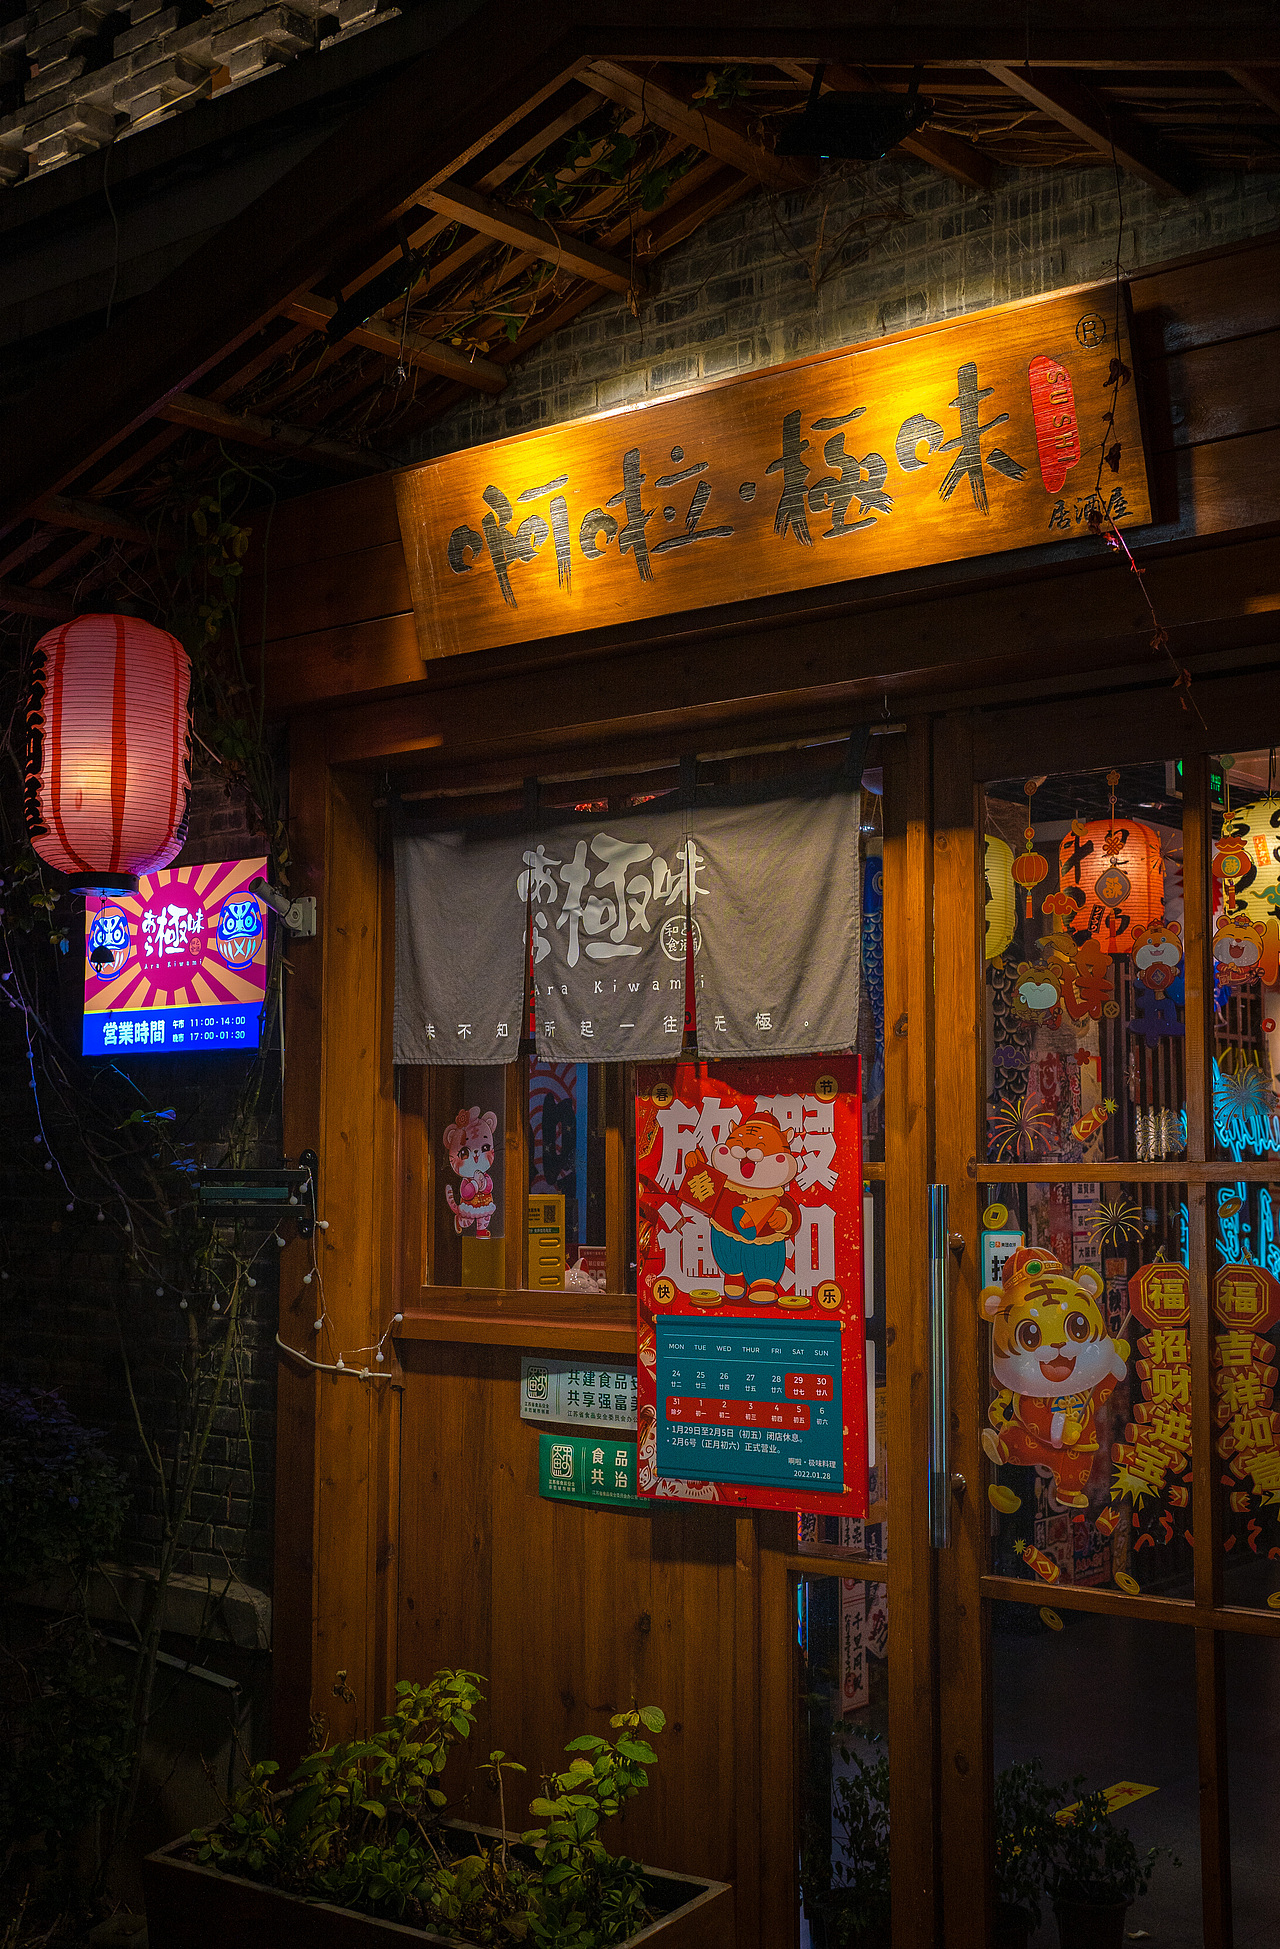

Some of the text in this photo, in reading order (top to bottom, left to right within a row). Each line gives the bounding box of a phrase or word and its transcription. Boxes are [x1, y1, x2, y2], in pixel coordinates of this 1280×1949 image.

[1046, 370, 1077, 462] SUSHI
[656, 1080, 832, 1102] 春 节
[657, 1284, 671, 1300] 快
[822, 1288, 836, 1304] 乐
[1148, 1277, 1186, 1310] 福
[1219, 1279, 1258, 1314] 福
[696, 1371, 705, 1379] 25
[719, 1372, 729, 1380] 26
[771, 1375, 781, 1383] 28
[793, 1376, 803, 1384] 29
[816, 1377, 827, 1385] 30
[699, 1399, 703, 1407] 1
[748, 1402, 753, 1410] 3
[796, 1405, 802, 1413] 5
[1127, 1328, 1192, 1488] 招财进宝
[591, 1447, 628, 1467] 食品
[591, 1468, 628, 1488] 共治
[793, 1470, 831, 1480] 2022.01.28
